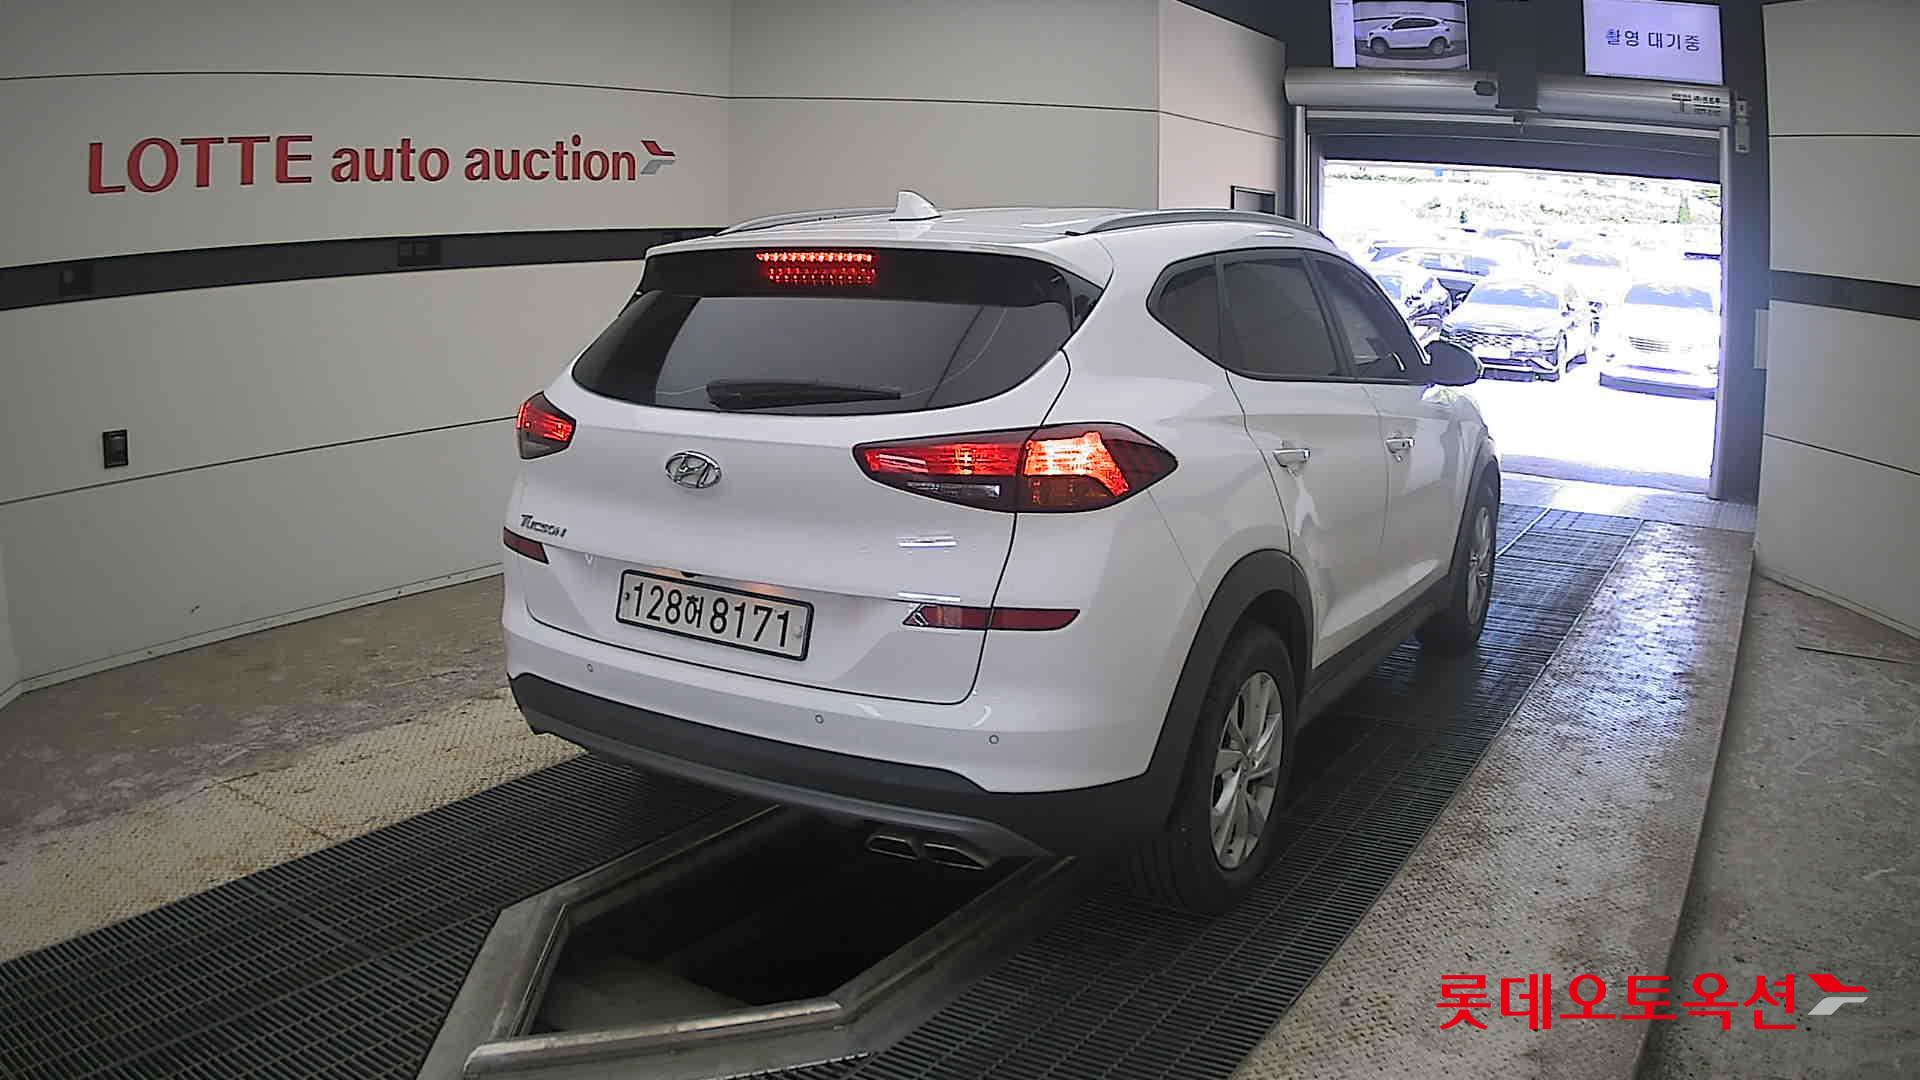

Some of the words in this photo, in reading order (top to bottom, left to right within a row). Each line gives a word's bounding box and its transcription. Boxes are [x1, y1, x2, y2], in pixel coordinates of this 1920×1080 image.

[1648, 31, 1701, 52] 대기중
[88, 135, 313, 194] LOTTE
[330, 138, 450, 183] auto
[464, 134, 637, 182] auction
